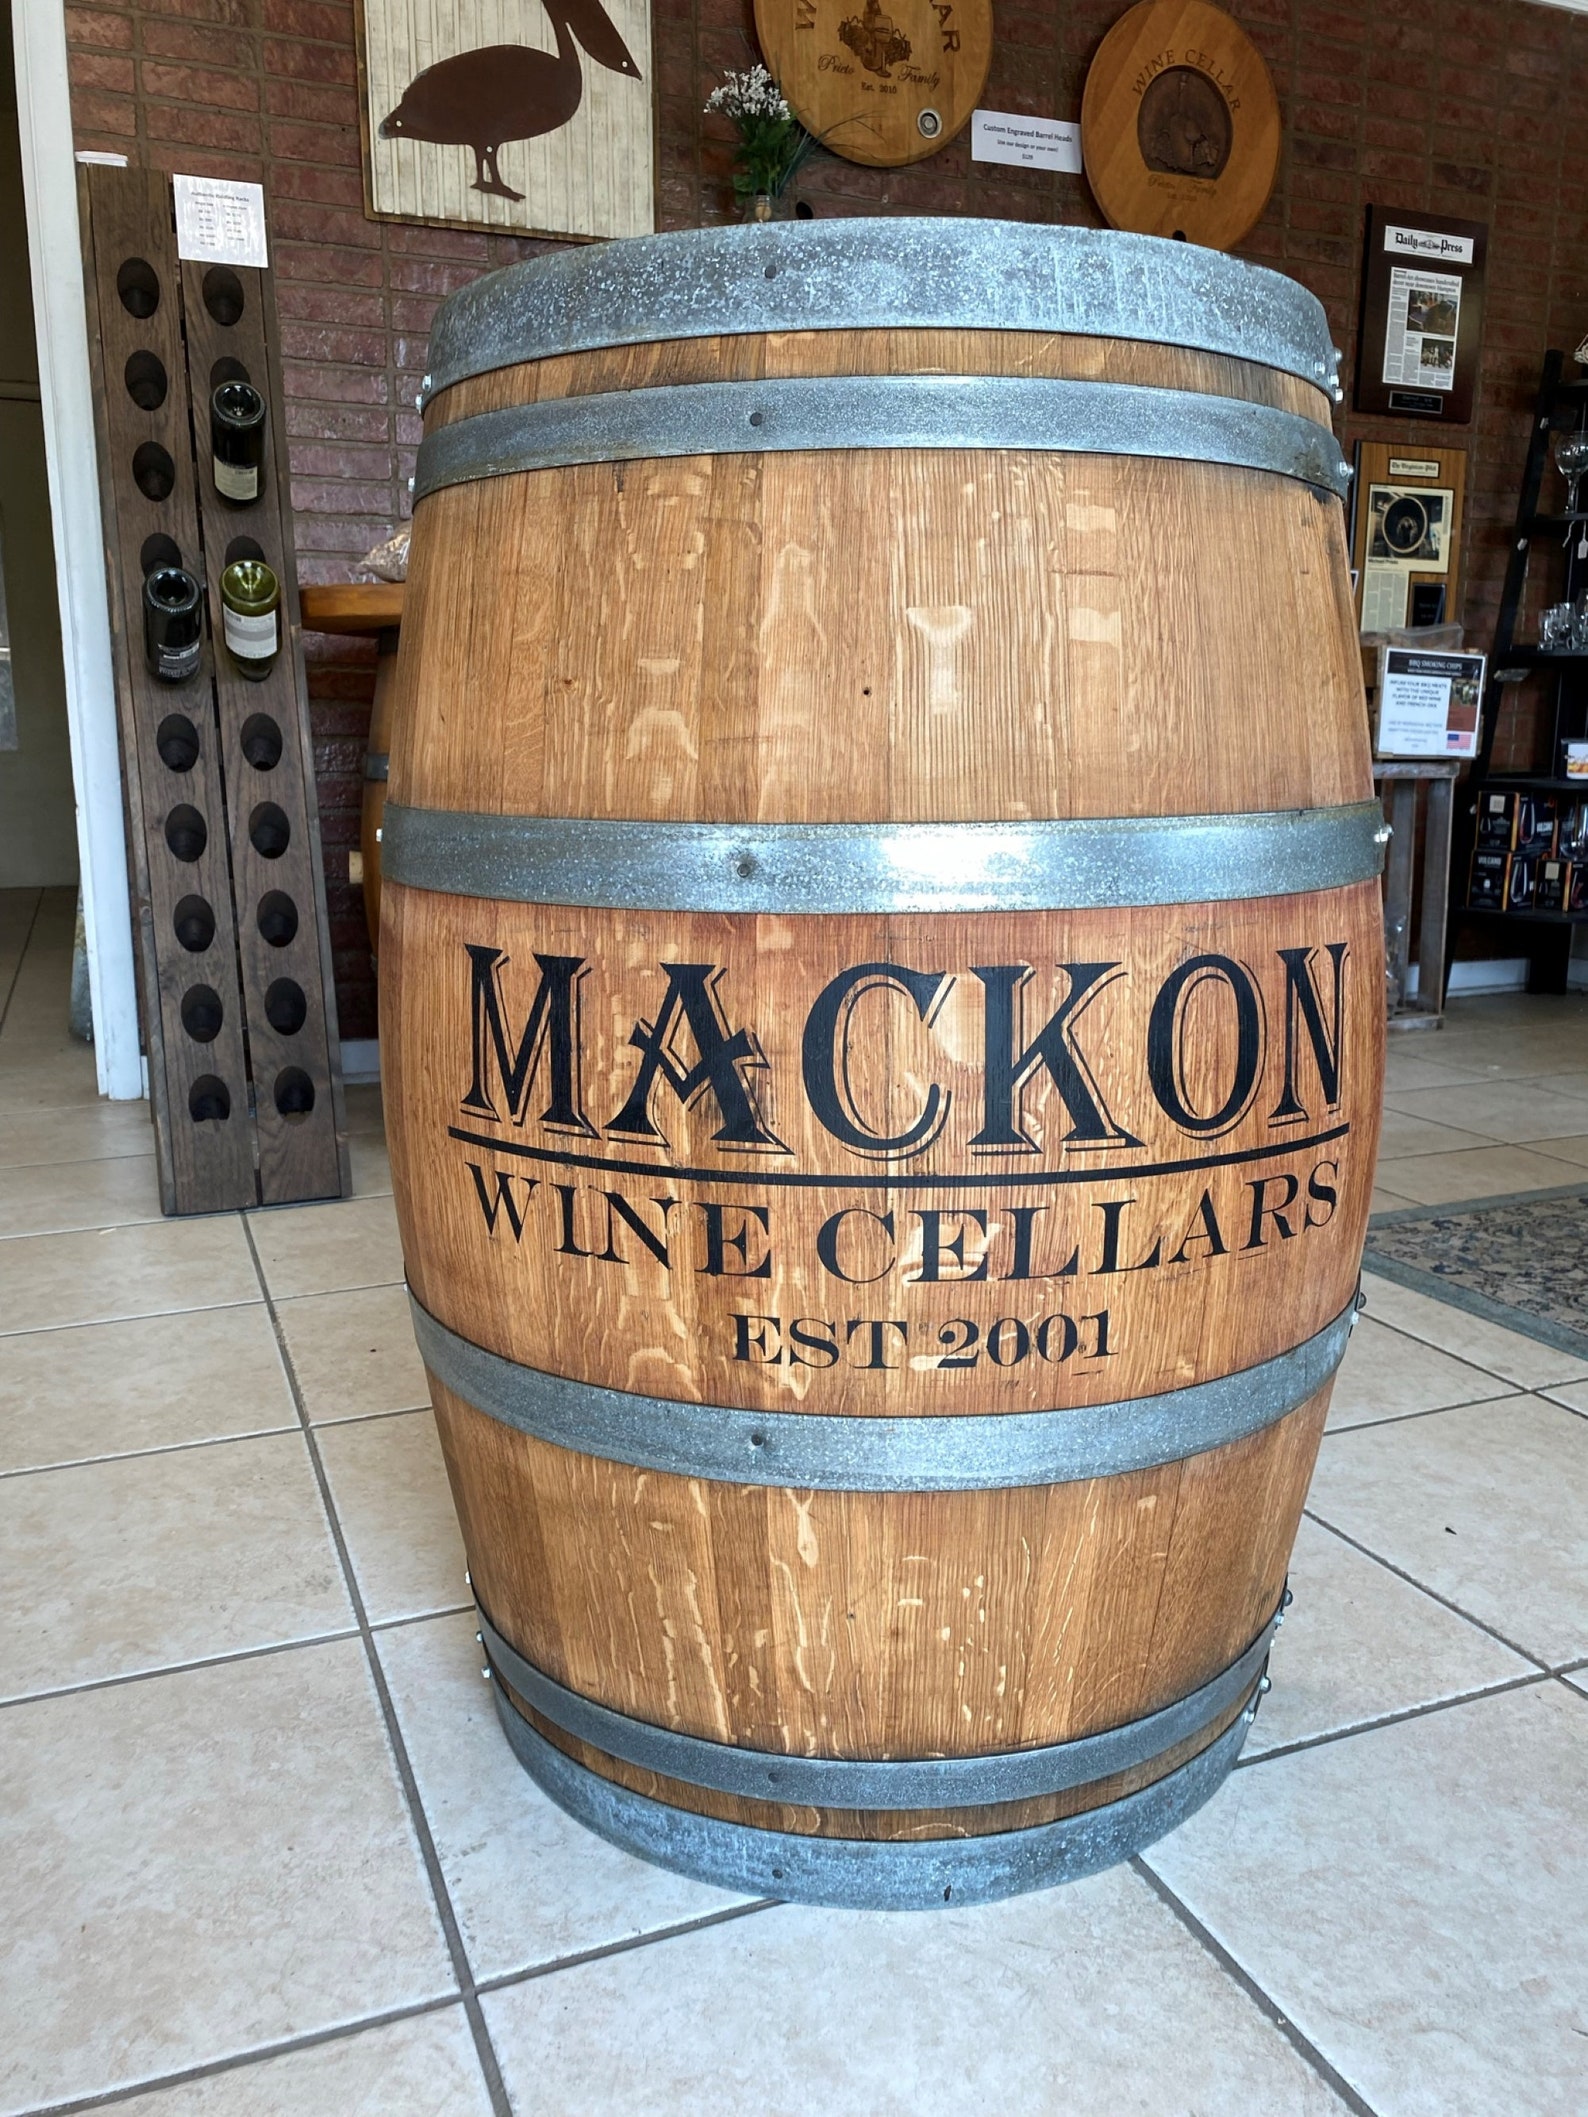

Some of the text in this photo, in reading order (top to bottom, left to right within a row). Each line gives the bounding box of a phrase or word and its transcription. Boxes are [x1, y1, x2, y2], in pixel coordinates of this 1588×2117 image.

[897, 64, 941, 93] Family
[1132, 49, 1241, 113] WINE CELLAR
[983, 123, 1006, 134] Custom
[1007, 127, 1035, 137] Engraved
[1035, 131, 1053, 141] Barrel
[1395, 232, 1464, 254] Daily Press
[460, 942, 1349, 1162] MACKON
[465, 1159, 1339, 1283] WINE CELLARS
[728, 1309, 1118, 1369] EST 2001
